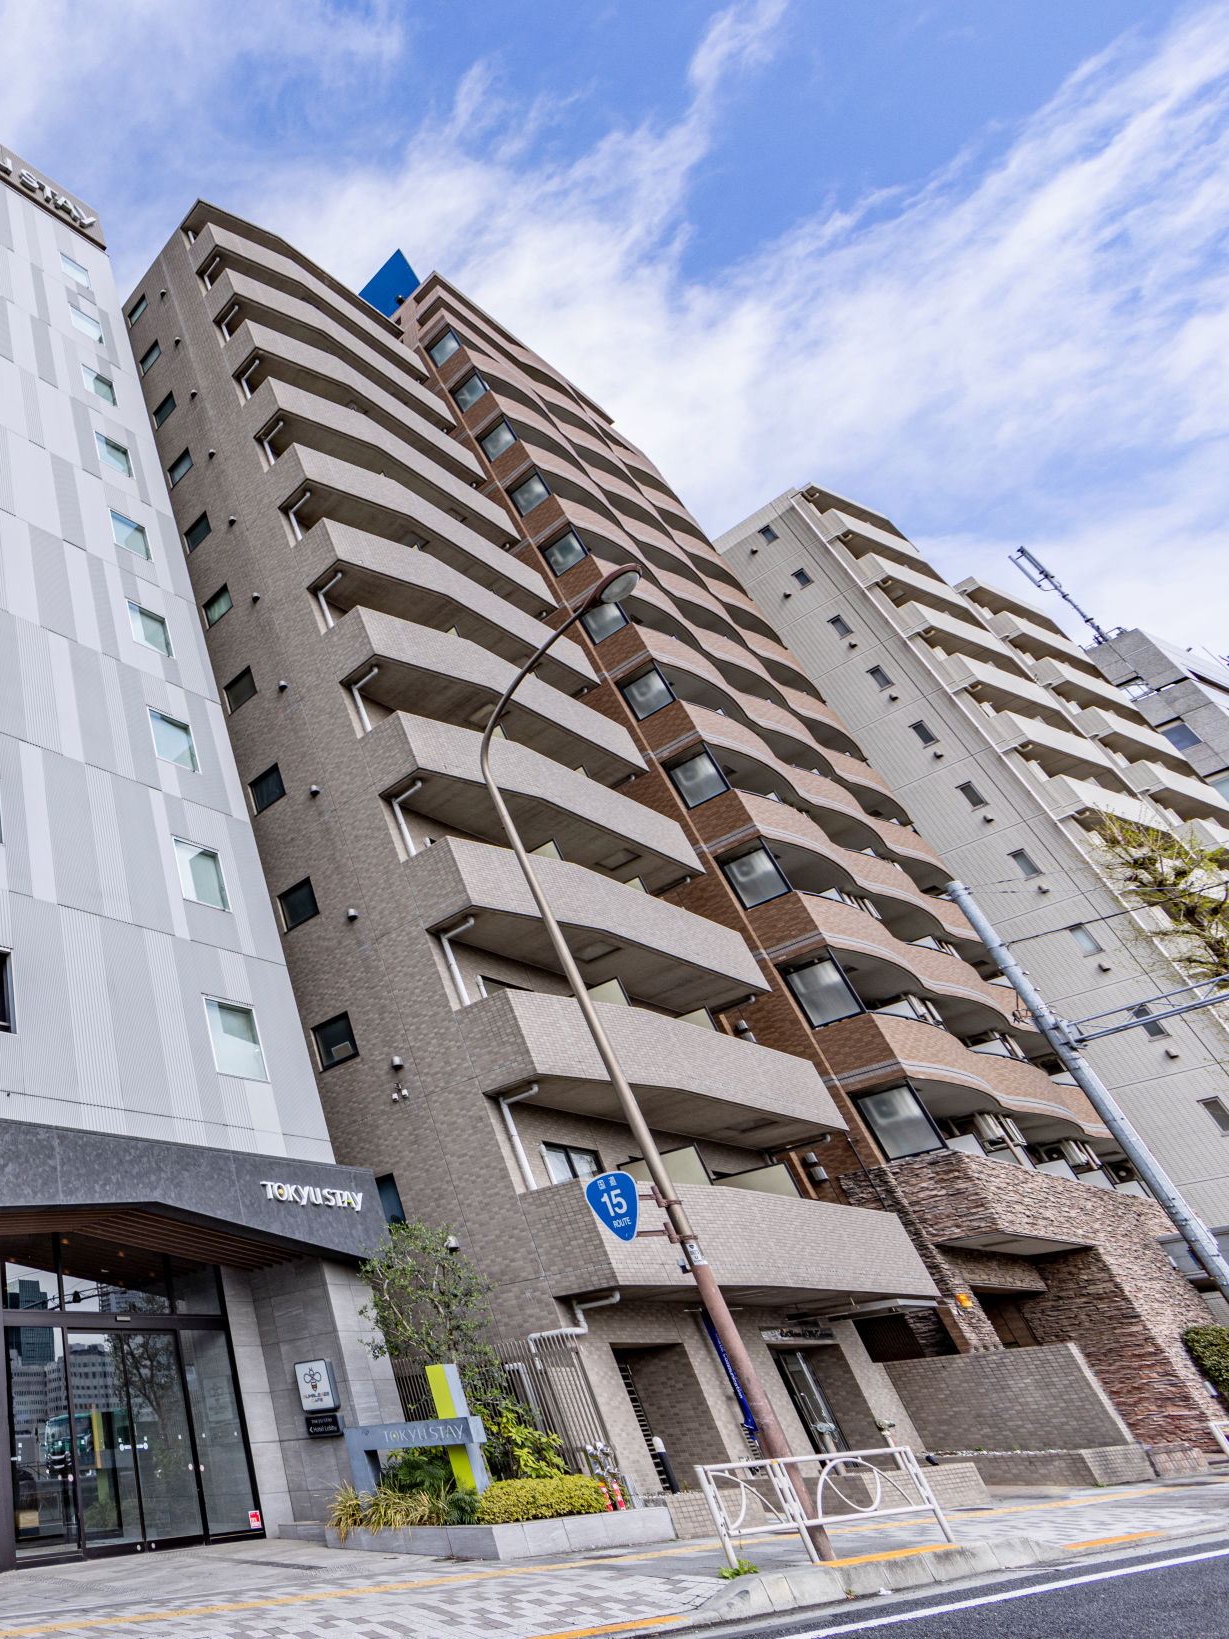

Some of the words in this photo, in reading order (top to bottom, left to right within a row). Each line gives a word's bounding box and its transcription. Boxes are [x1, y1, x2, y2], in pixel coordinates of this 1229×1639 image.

[19, 168, 97, 228] STAY
[260, 1180, 323, 1206] TOKYU
[322, 1188, 363, 1212] STAY
[601, 1189, 628, 1217] 15
[613, 1217, 631, 1228] ROUTE
[382, 1428, 427, 1443] TOKYU
[429, 1424, 463, 1442] STAY
